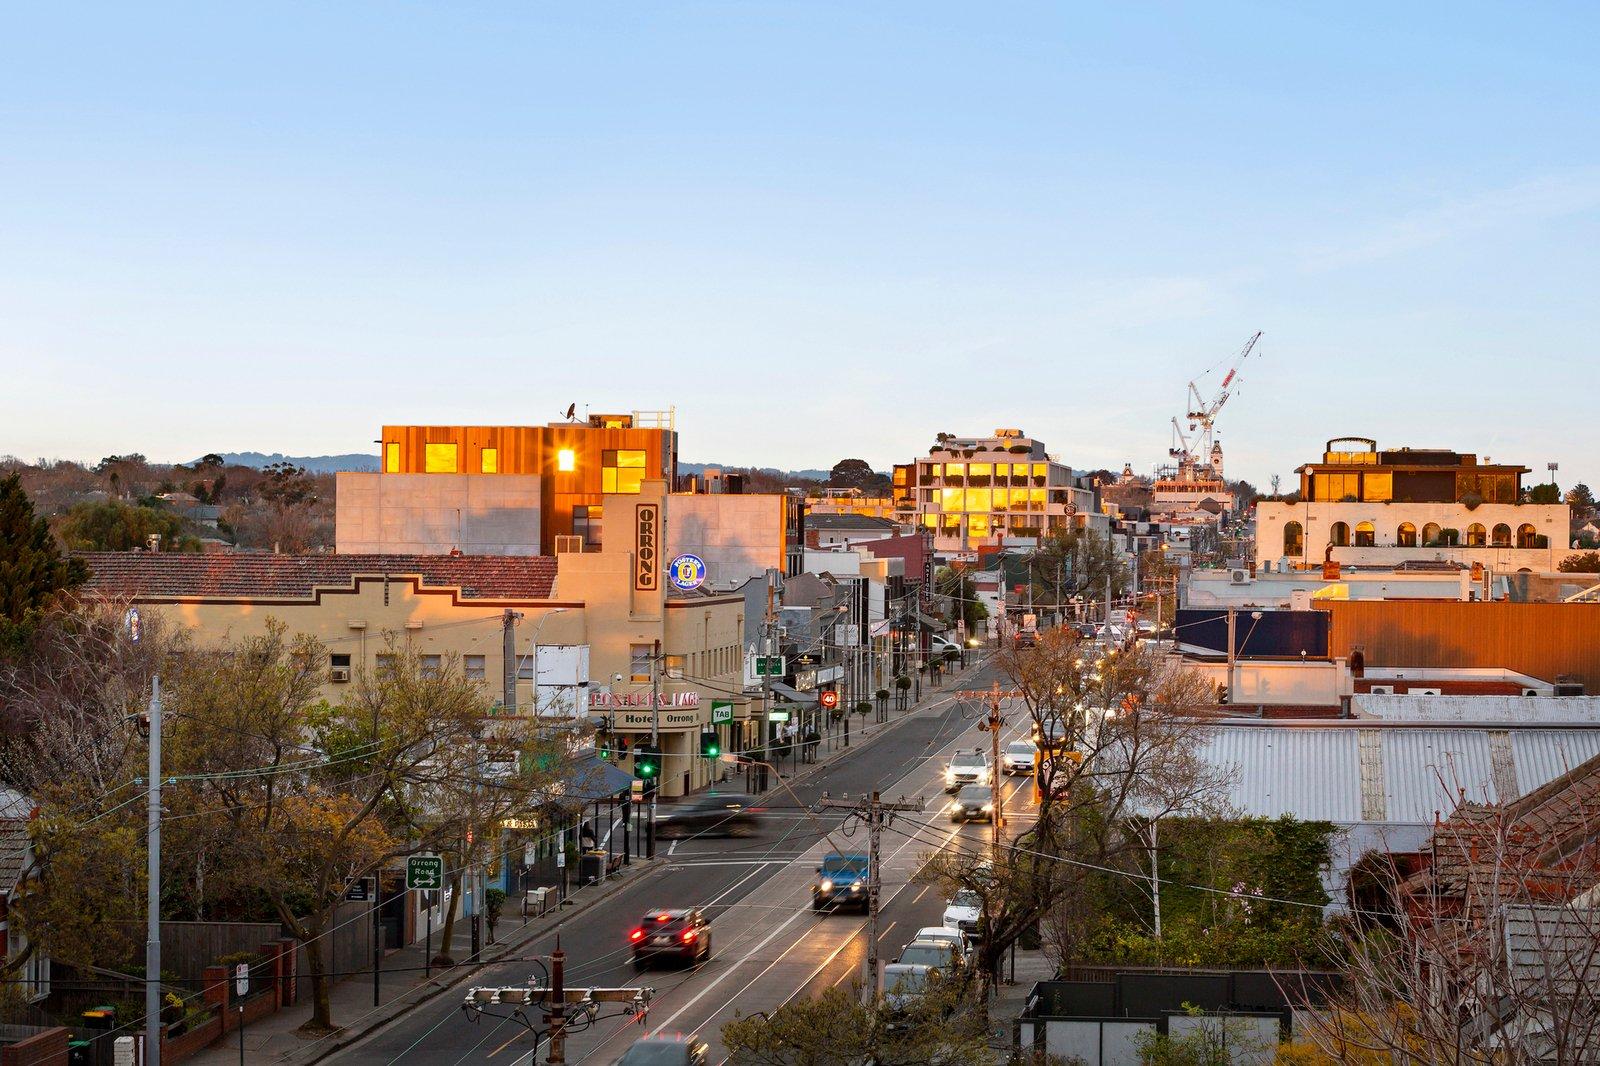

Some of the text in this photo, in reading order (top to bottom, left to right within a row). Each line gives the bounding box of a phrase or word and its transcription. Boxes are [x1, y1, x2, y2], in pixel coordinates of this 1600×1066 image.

[639, 509, 654, 586] ORRONG
[825, 694, 834, 702] 40
[715, 710, 730, 718] TAB
[625, 714, 693, 723] Hote Orrong
[411, 859, 439, 869] Orrong
[414, 868, 435, 876] Road
